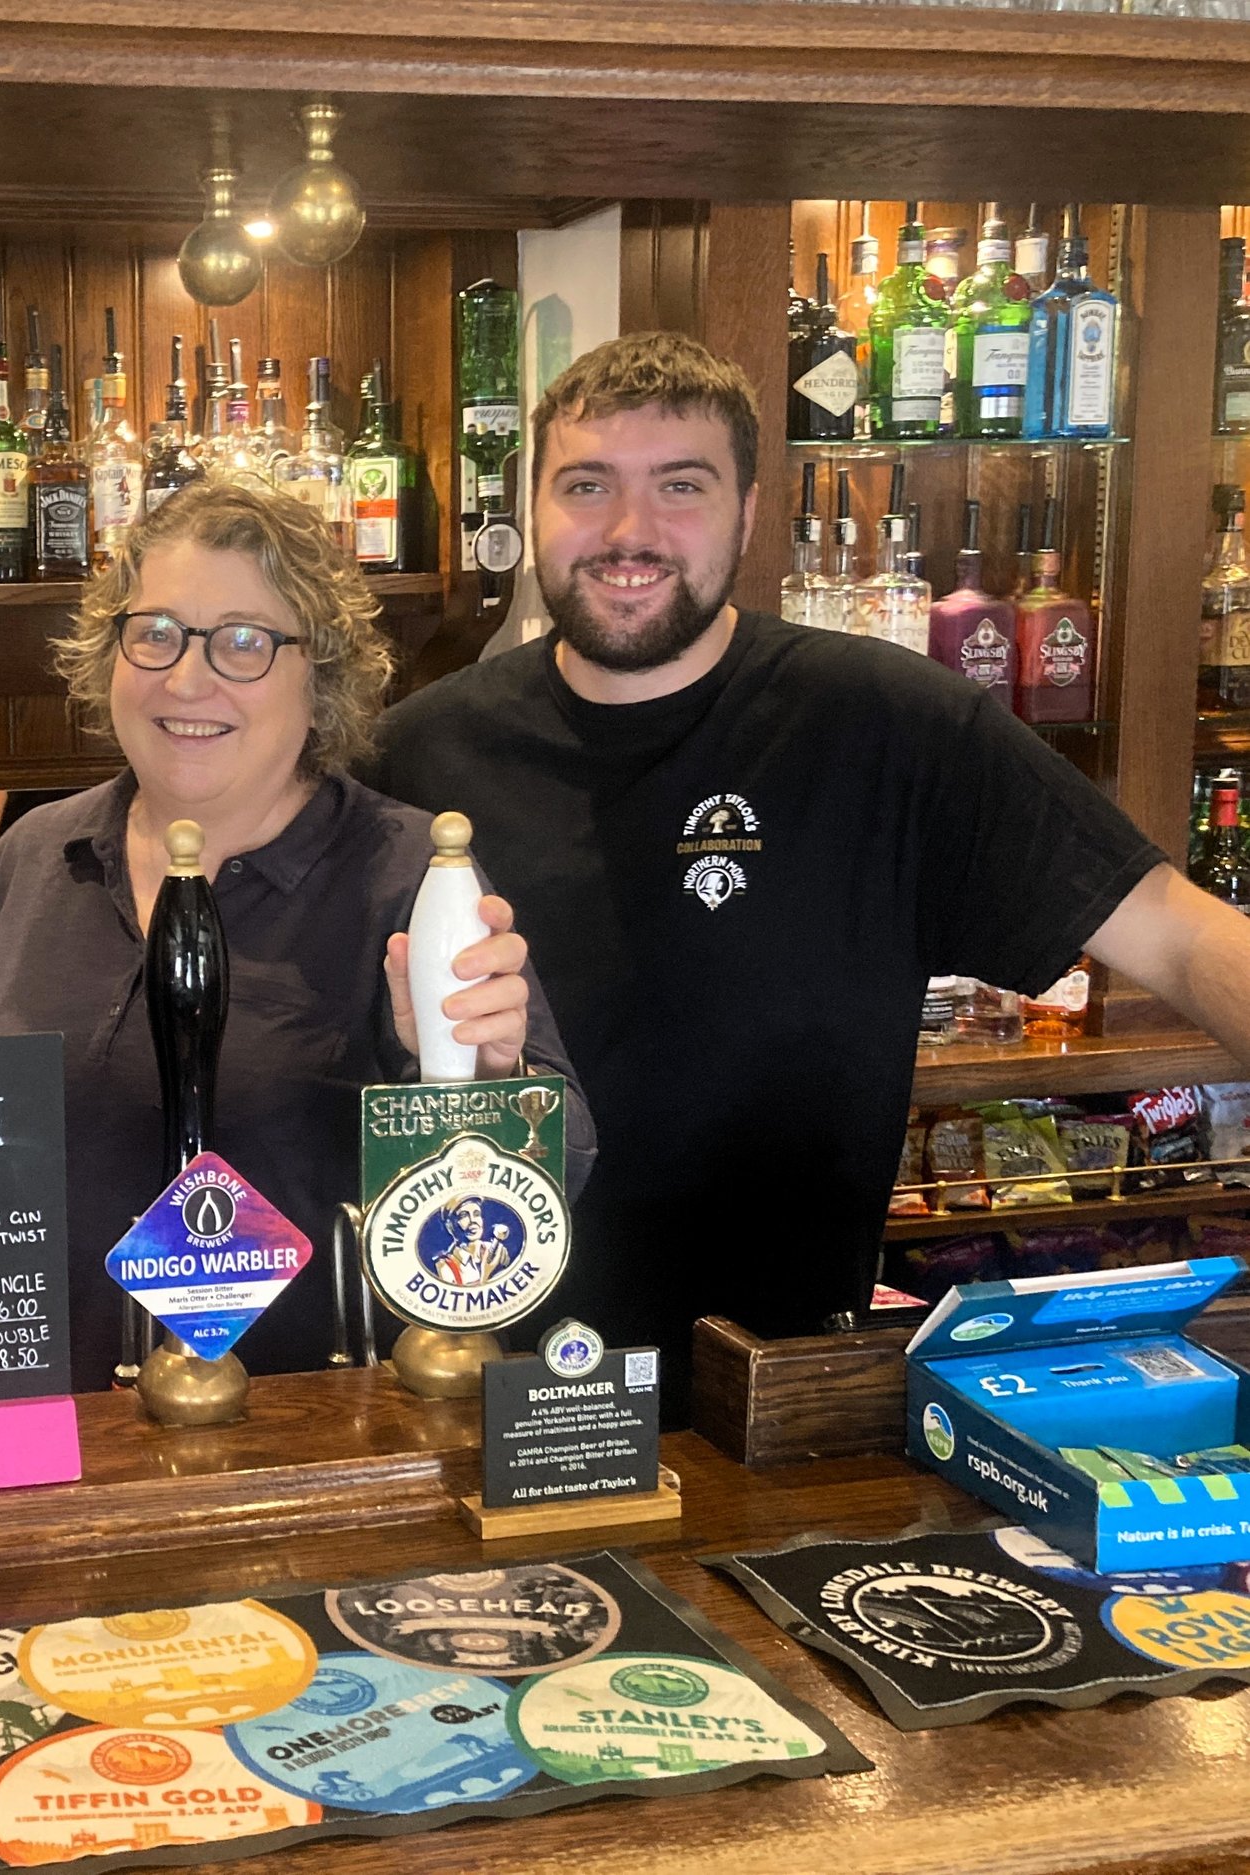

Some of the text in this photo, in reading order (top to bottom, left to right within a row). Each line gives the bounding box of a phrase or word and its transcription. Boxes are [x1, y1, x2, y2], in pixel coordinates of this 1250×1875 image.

[41, 491, 59, 508] JACK
[1039, 644, 1088, 663] SLINGSBY
[683, 793, 761, 836] TIMOTHY TAYLOR'S
[676, 839, 763, 854] COLLABORATION
[683, 855, 747, 889] NORTHERN MONK
[369, 1090, 506, 1117] CHAMPION
[1133, 1086, 1199, 1134] Twiglets
[370, 1111, 502, 1137] CLUB MEMBER
[169, 1170, 247, 1208] WISHBONE
[9, 1210, 41, 1225] GIN
[382, 1163, 557, 1257] TIMOTHY TAYLOR'S
[186, 1230, 234, 1249] BREWERY
[121, 1247, 299, 1281] INDIGO WARBLER
[187, 1285, 234, 1295] Session Bitter
[216, 1292, 252, 1301] Challenger
[406, 1261, 540, 1313] BOLTMAKER
[193, 1328, 230, 1338] ALC 3.7%
[528, 1382, 615, 1402] BOLTMAKER
[979, 1374, 1037, 1397] £2
[1060, 1374, 1129, 1389] Thank you
[512, 1476, 636, 1499] All for that taste of Taylor's
[967, 1453, 1048, 1513] rspb.org.uk
[1117, 1523, 1235, 1544] Nature is in crisis.
[820, 1562, 921, 1610] LONSDALE
[930, 1564, 1074, 1618] BREWERY
[354, 1597, 591, 1617] LOOSEHEAD
[52, 1630, 278, 1668] MONUMENTAL
[826, 1610, 938, 1669] KIRKBY
[577, 1709, 766, 1733] STANLEY'S
[33, 1786, 263, 1810] TIFFIN GOLD
